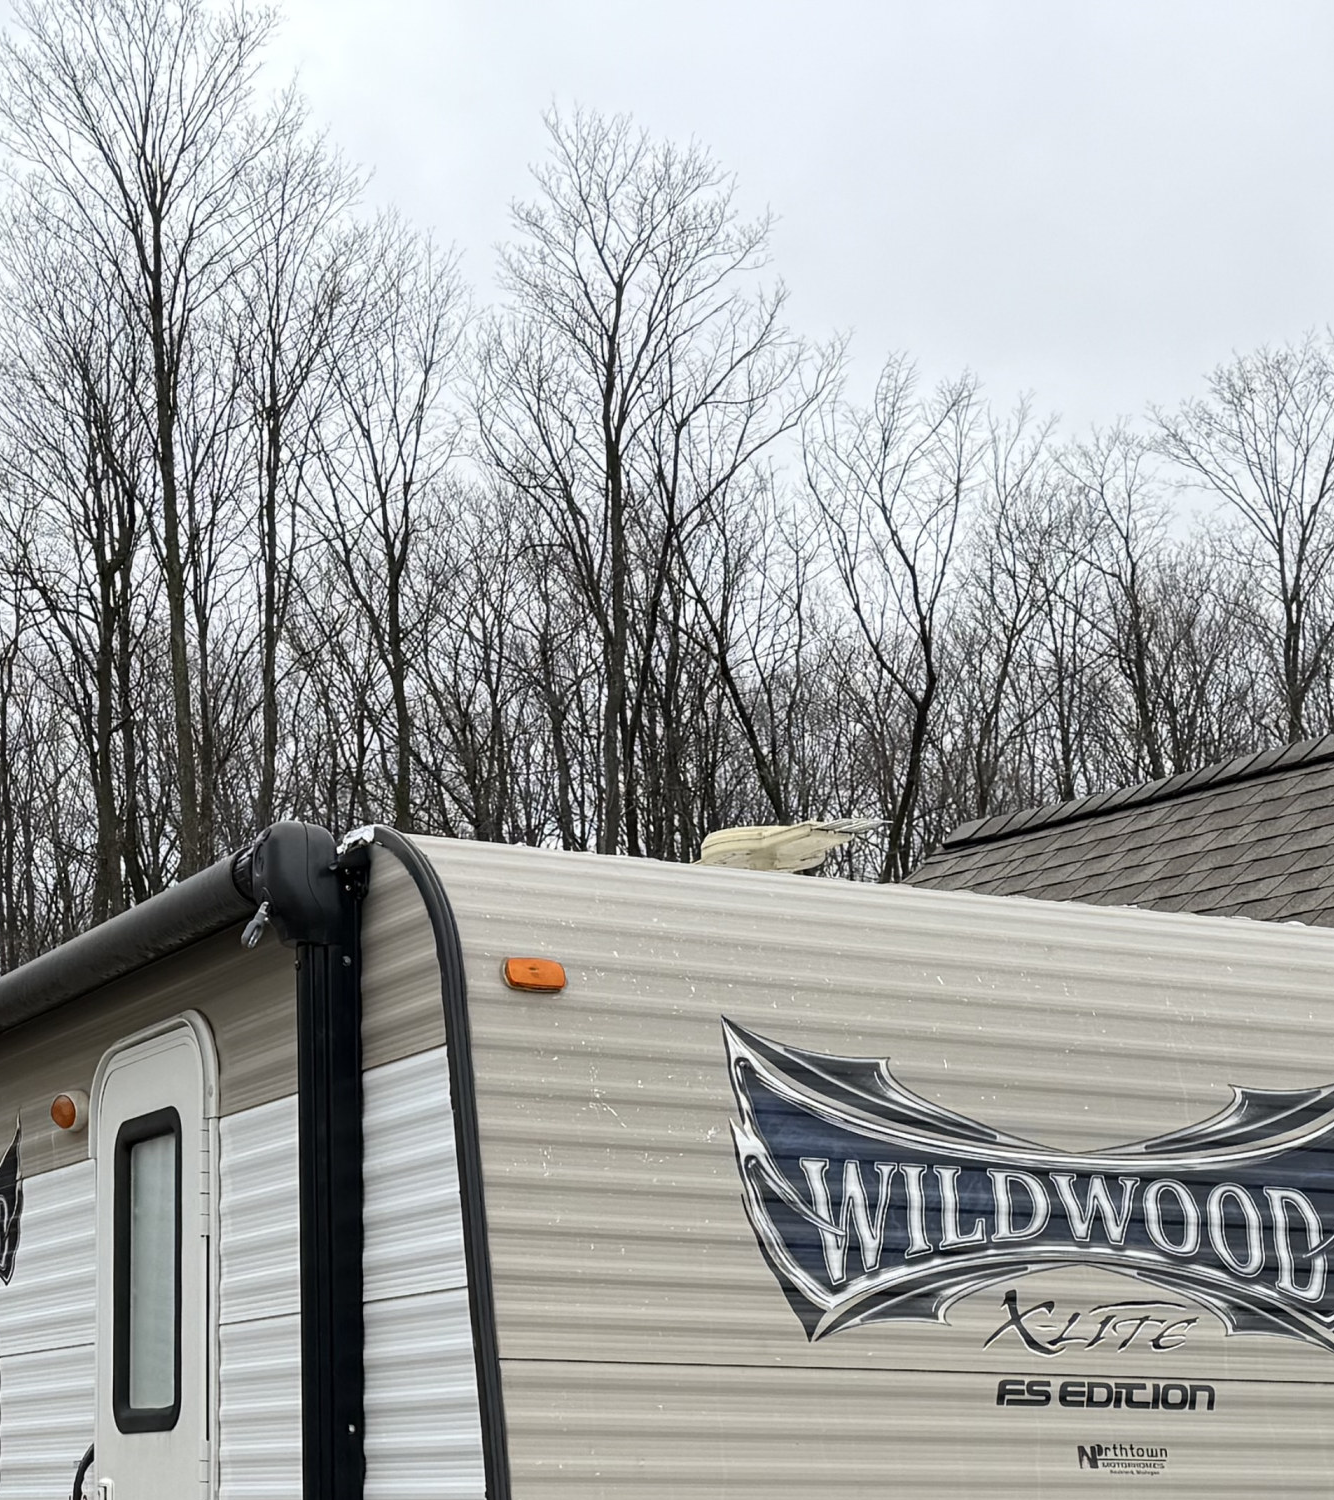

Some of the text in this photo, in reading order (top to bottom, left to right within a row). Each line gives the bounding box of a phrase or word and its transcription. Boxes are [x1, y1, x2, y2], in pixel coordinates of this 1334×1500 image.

[800, 1157, 1328, 1303] WILDWOOD
[982, 1289, 1200, 1358] X-LITE
[1058, 1381, 1216, 1411] EDITION
